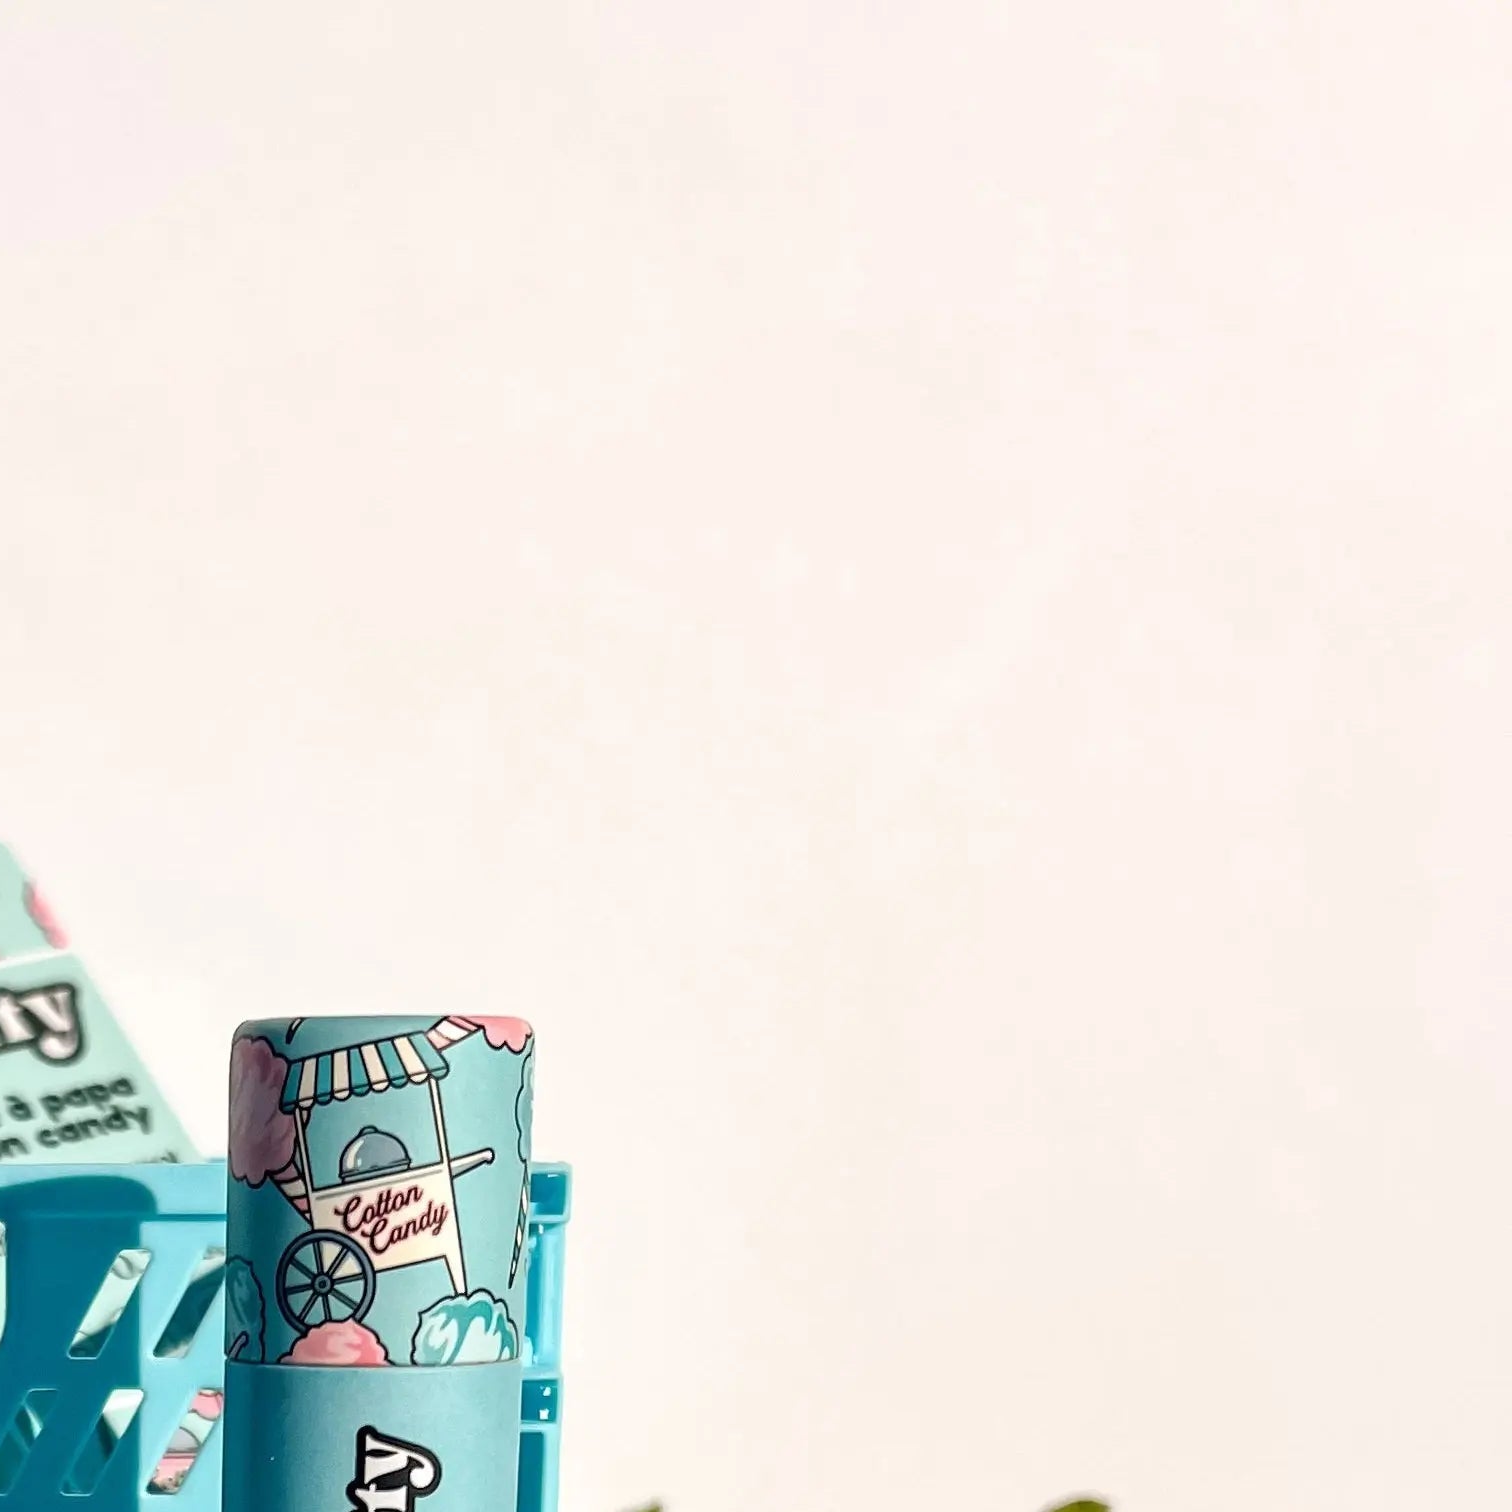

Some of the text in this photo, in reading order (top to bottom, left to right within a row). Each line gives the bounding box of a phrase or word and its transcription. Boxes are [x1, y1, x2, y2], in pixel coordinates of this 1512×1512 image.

[39, 1077, 136, 1122] papa
[36, 1105, 152, 1149] candy
[333, 1184, 423, 1233] Cotton
[360, 1200, 448, 1255] Candy
